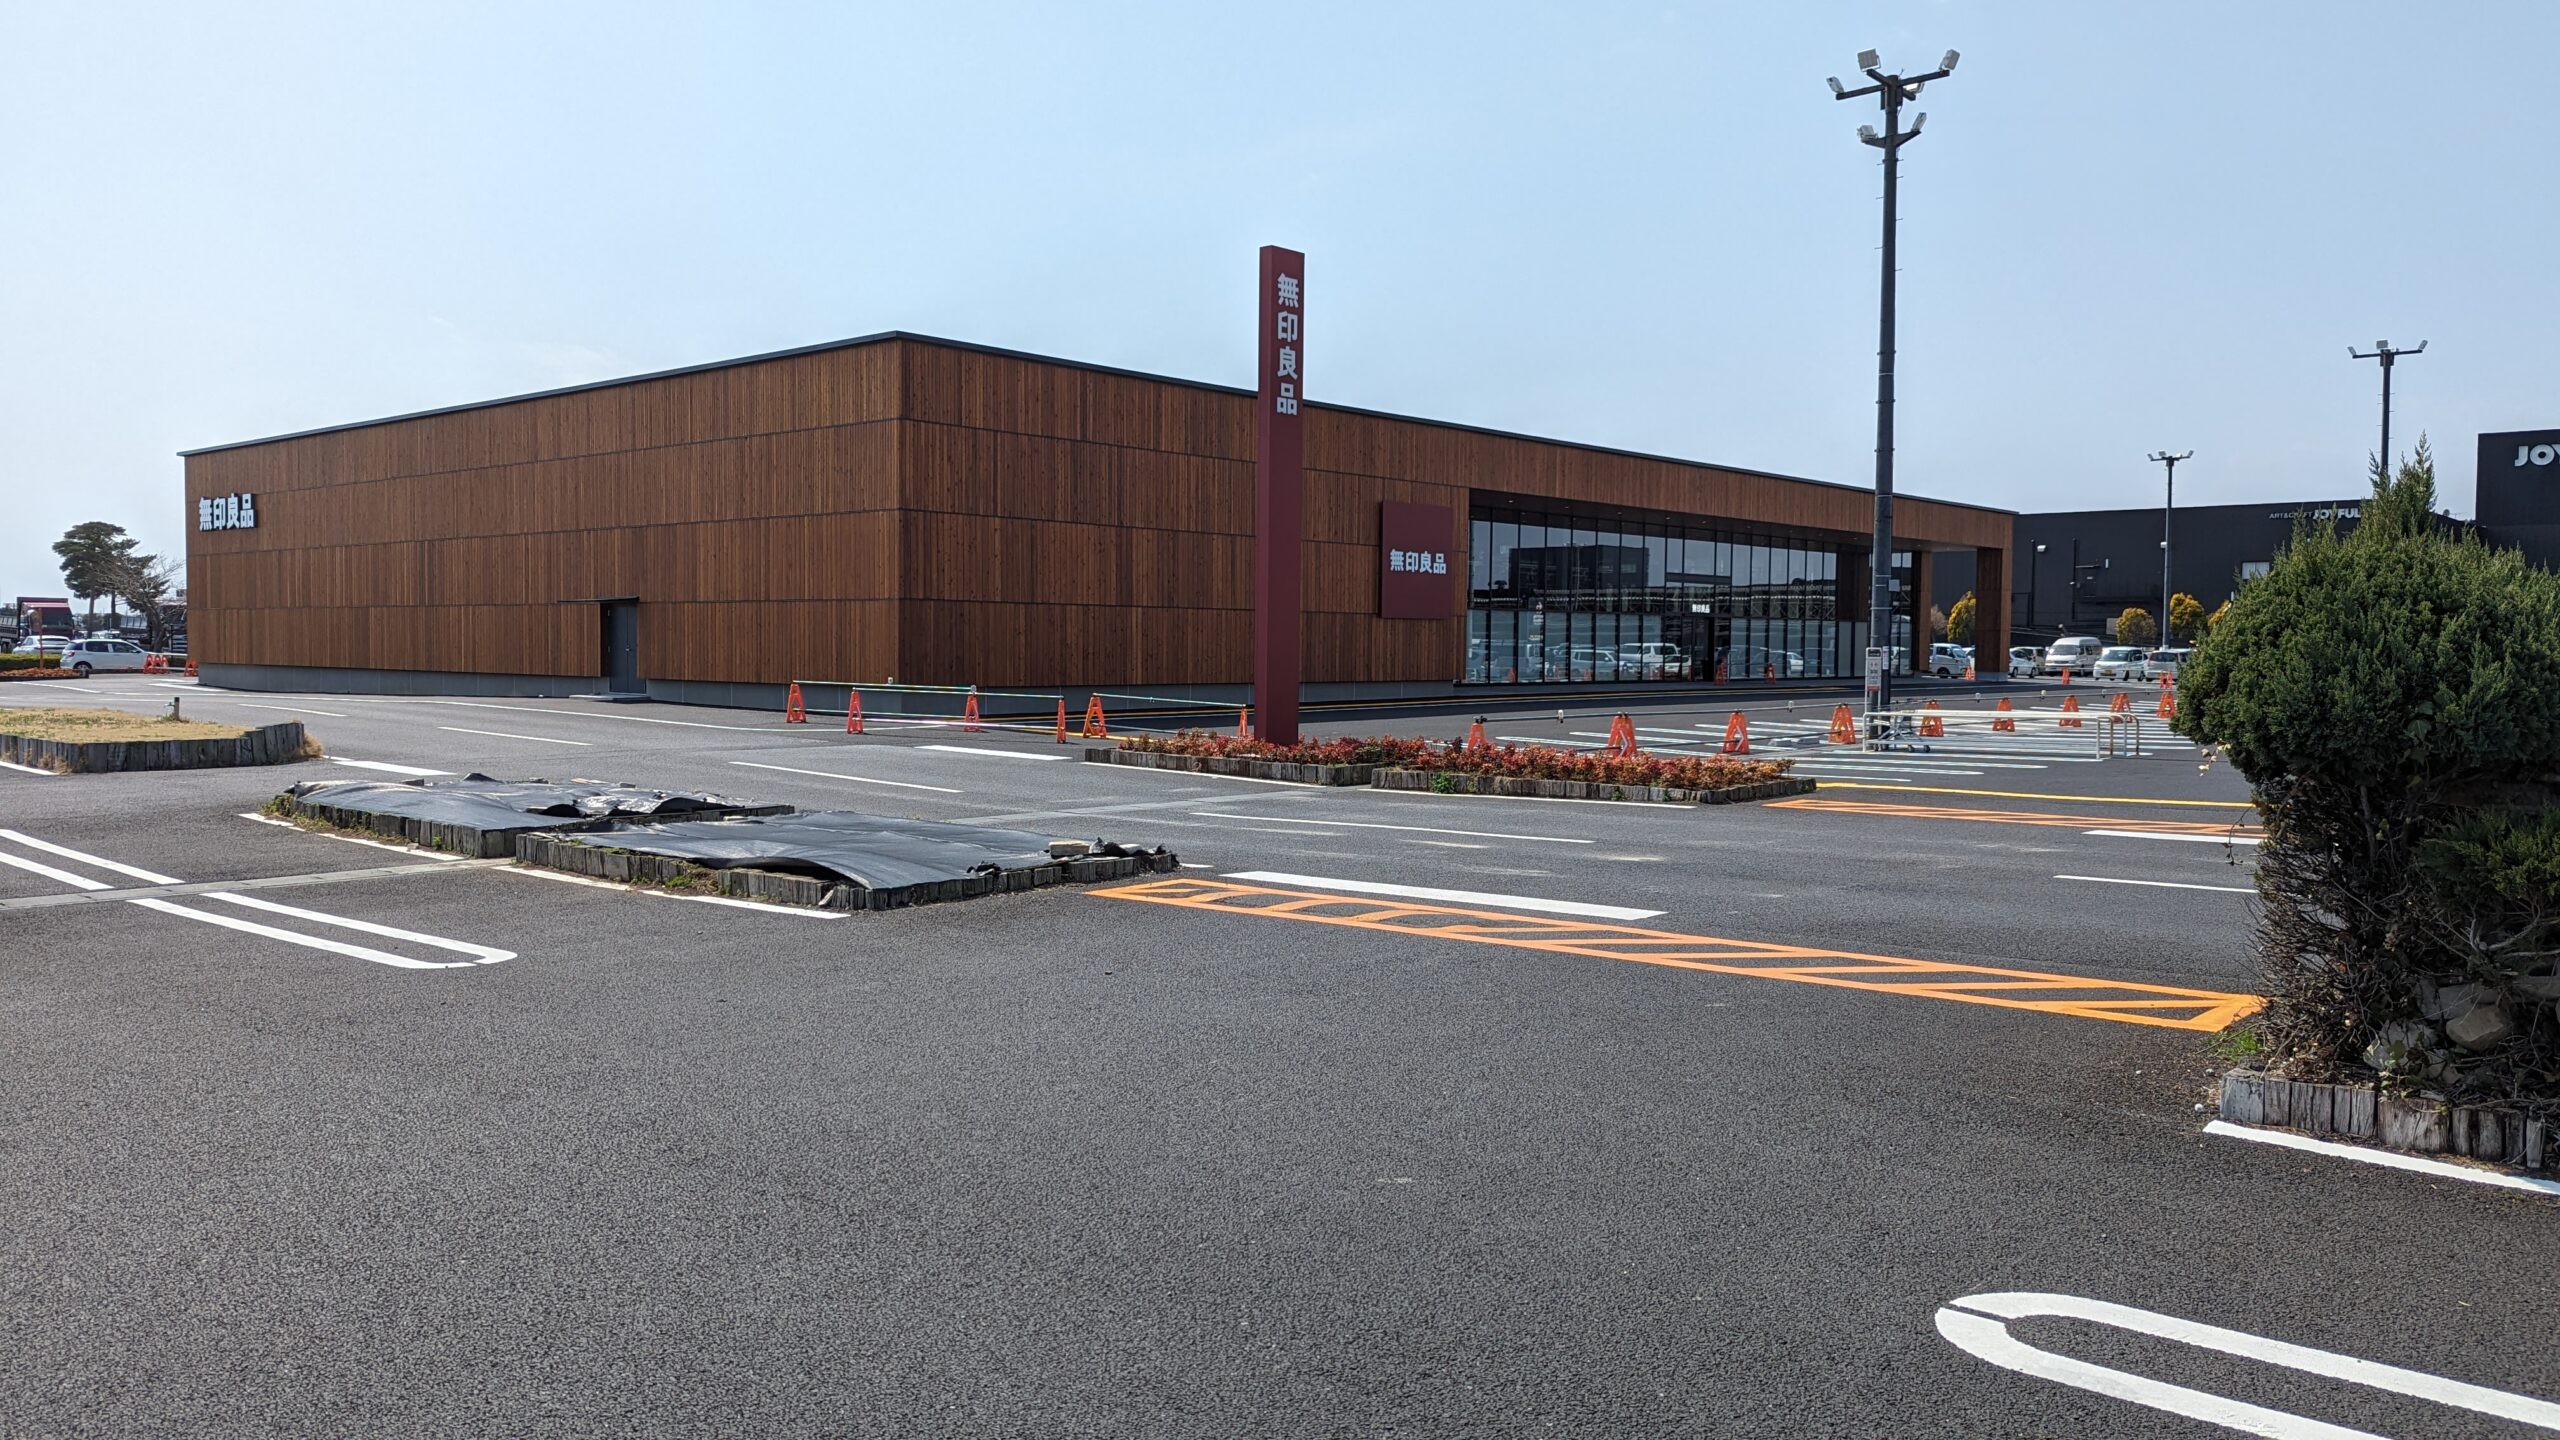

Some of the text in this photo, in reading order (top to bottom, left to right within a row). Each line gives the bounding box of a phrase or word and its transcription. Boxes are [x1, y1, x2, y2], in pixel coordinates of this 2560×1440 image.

[1277, 272, 1299, 416] 無印良品
[199, 492, 254, 531] 無印良品
[1390, 548, 1447, 575] 無印良品
